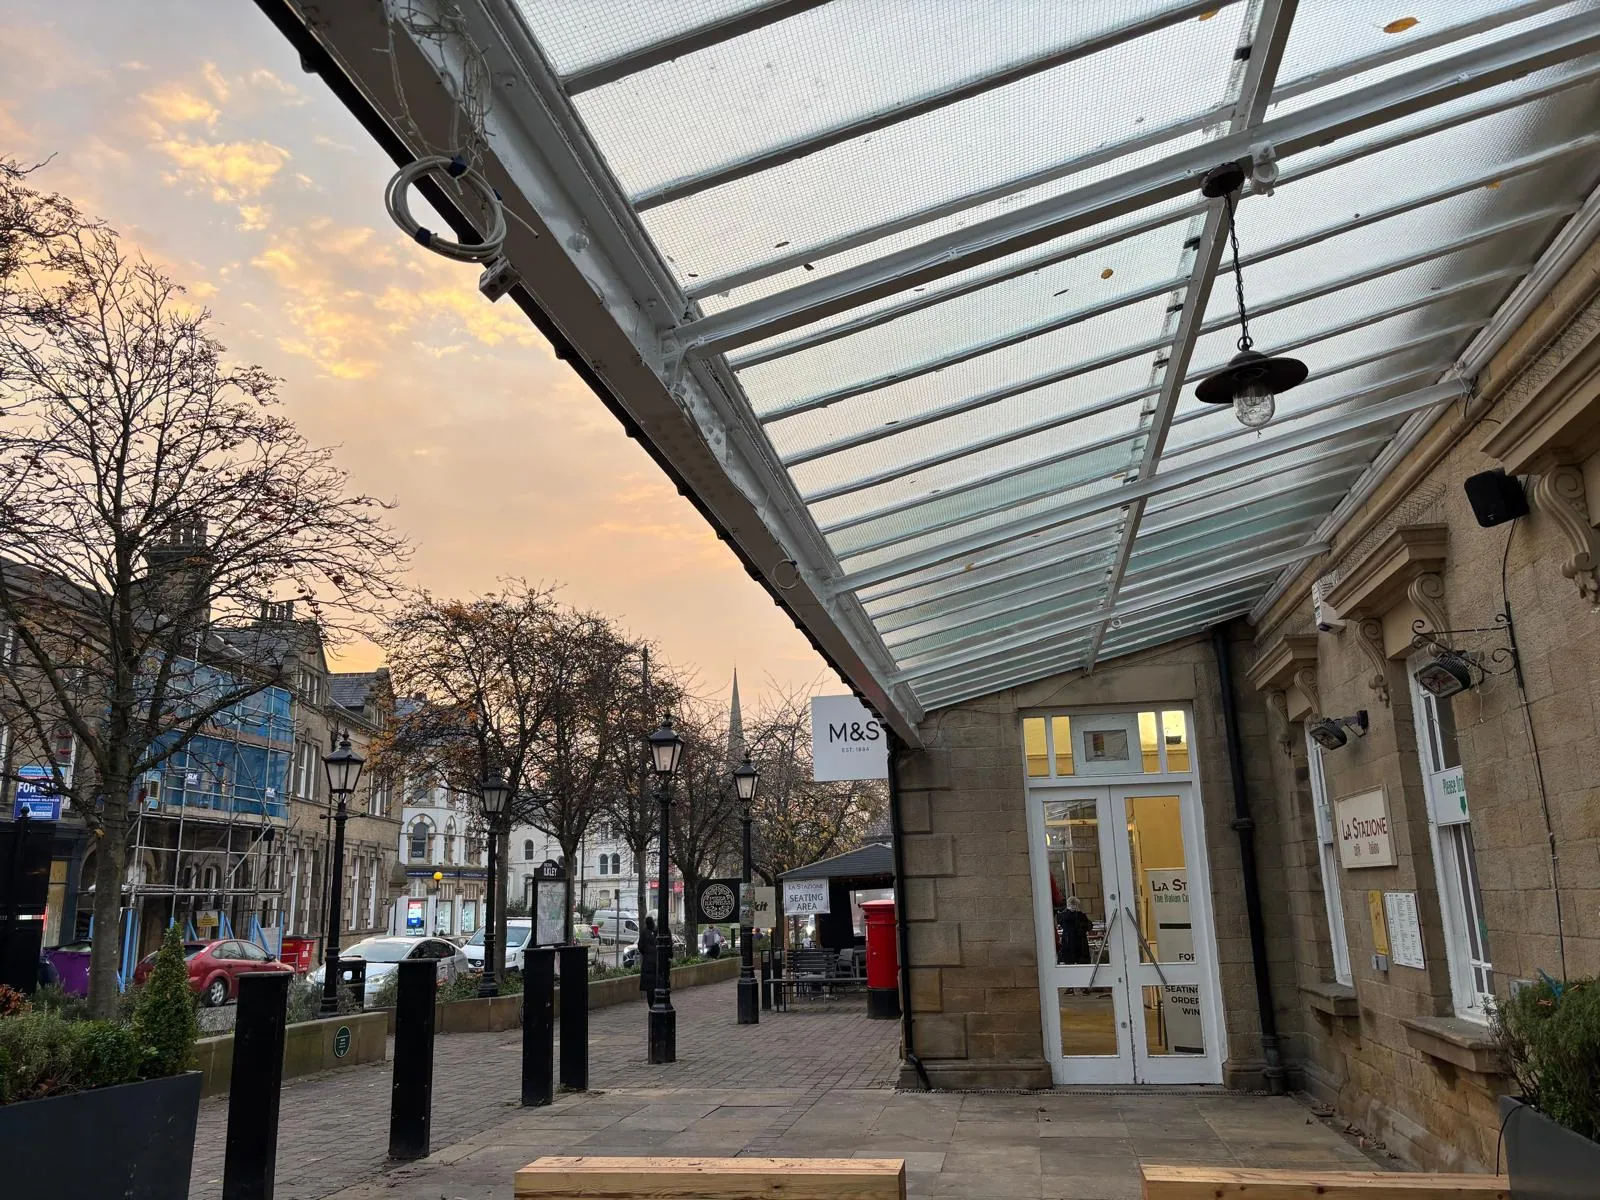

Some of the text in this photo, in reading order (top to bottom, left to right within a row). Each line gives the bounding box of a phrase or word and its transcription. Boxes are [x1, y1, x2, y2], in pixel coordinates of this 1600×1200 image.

[829, 721, 880, 743] M&S
[1341, 817, 1388, 841] LA STAZIONE
[1151, 880, 1170, 892] LA
[789, 893, 824, 903] SEATING
[796, 902, 818, 911] AREA
